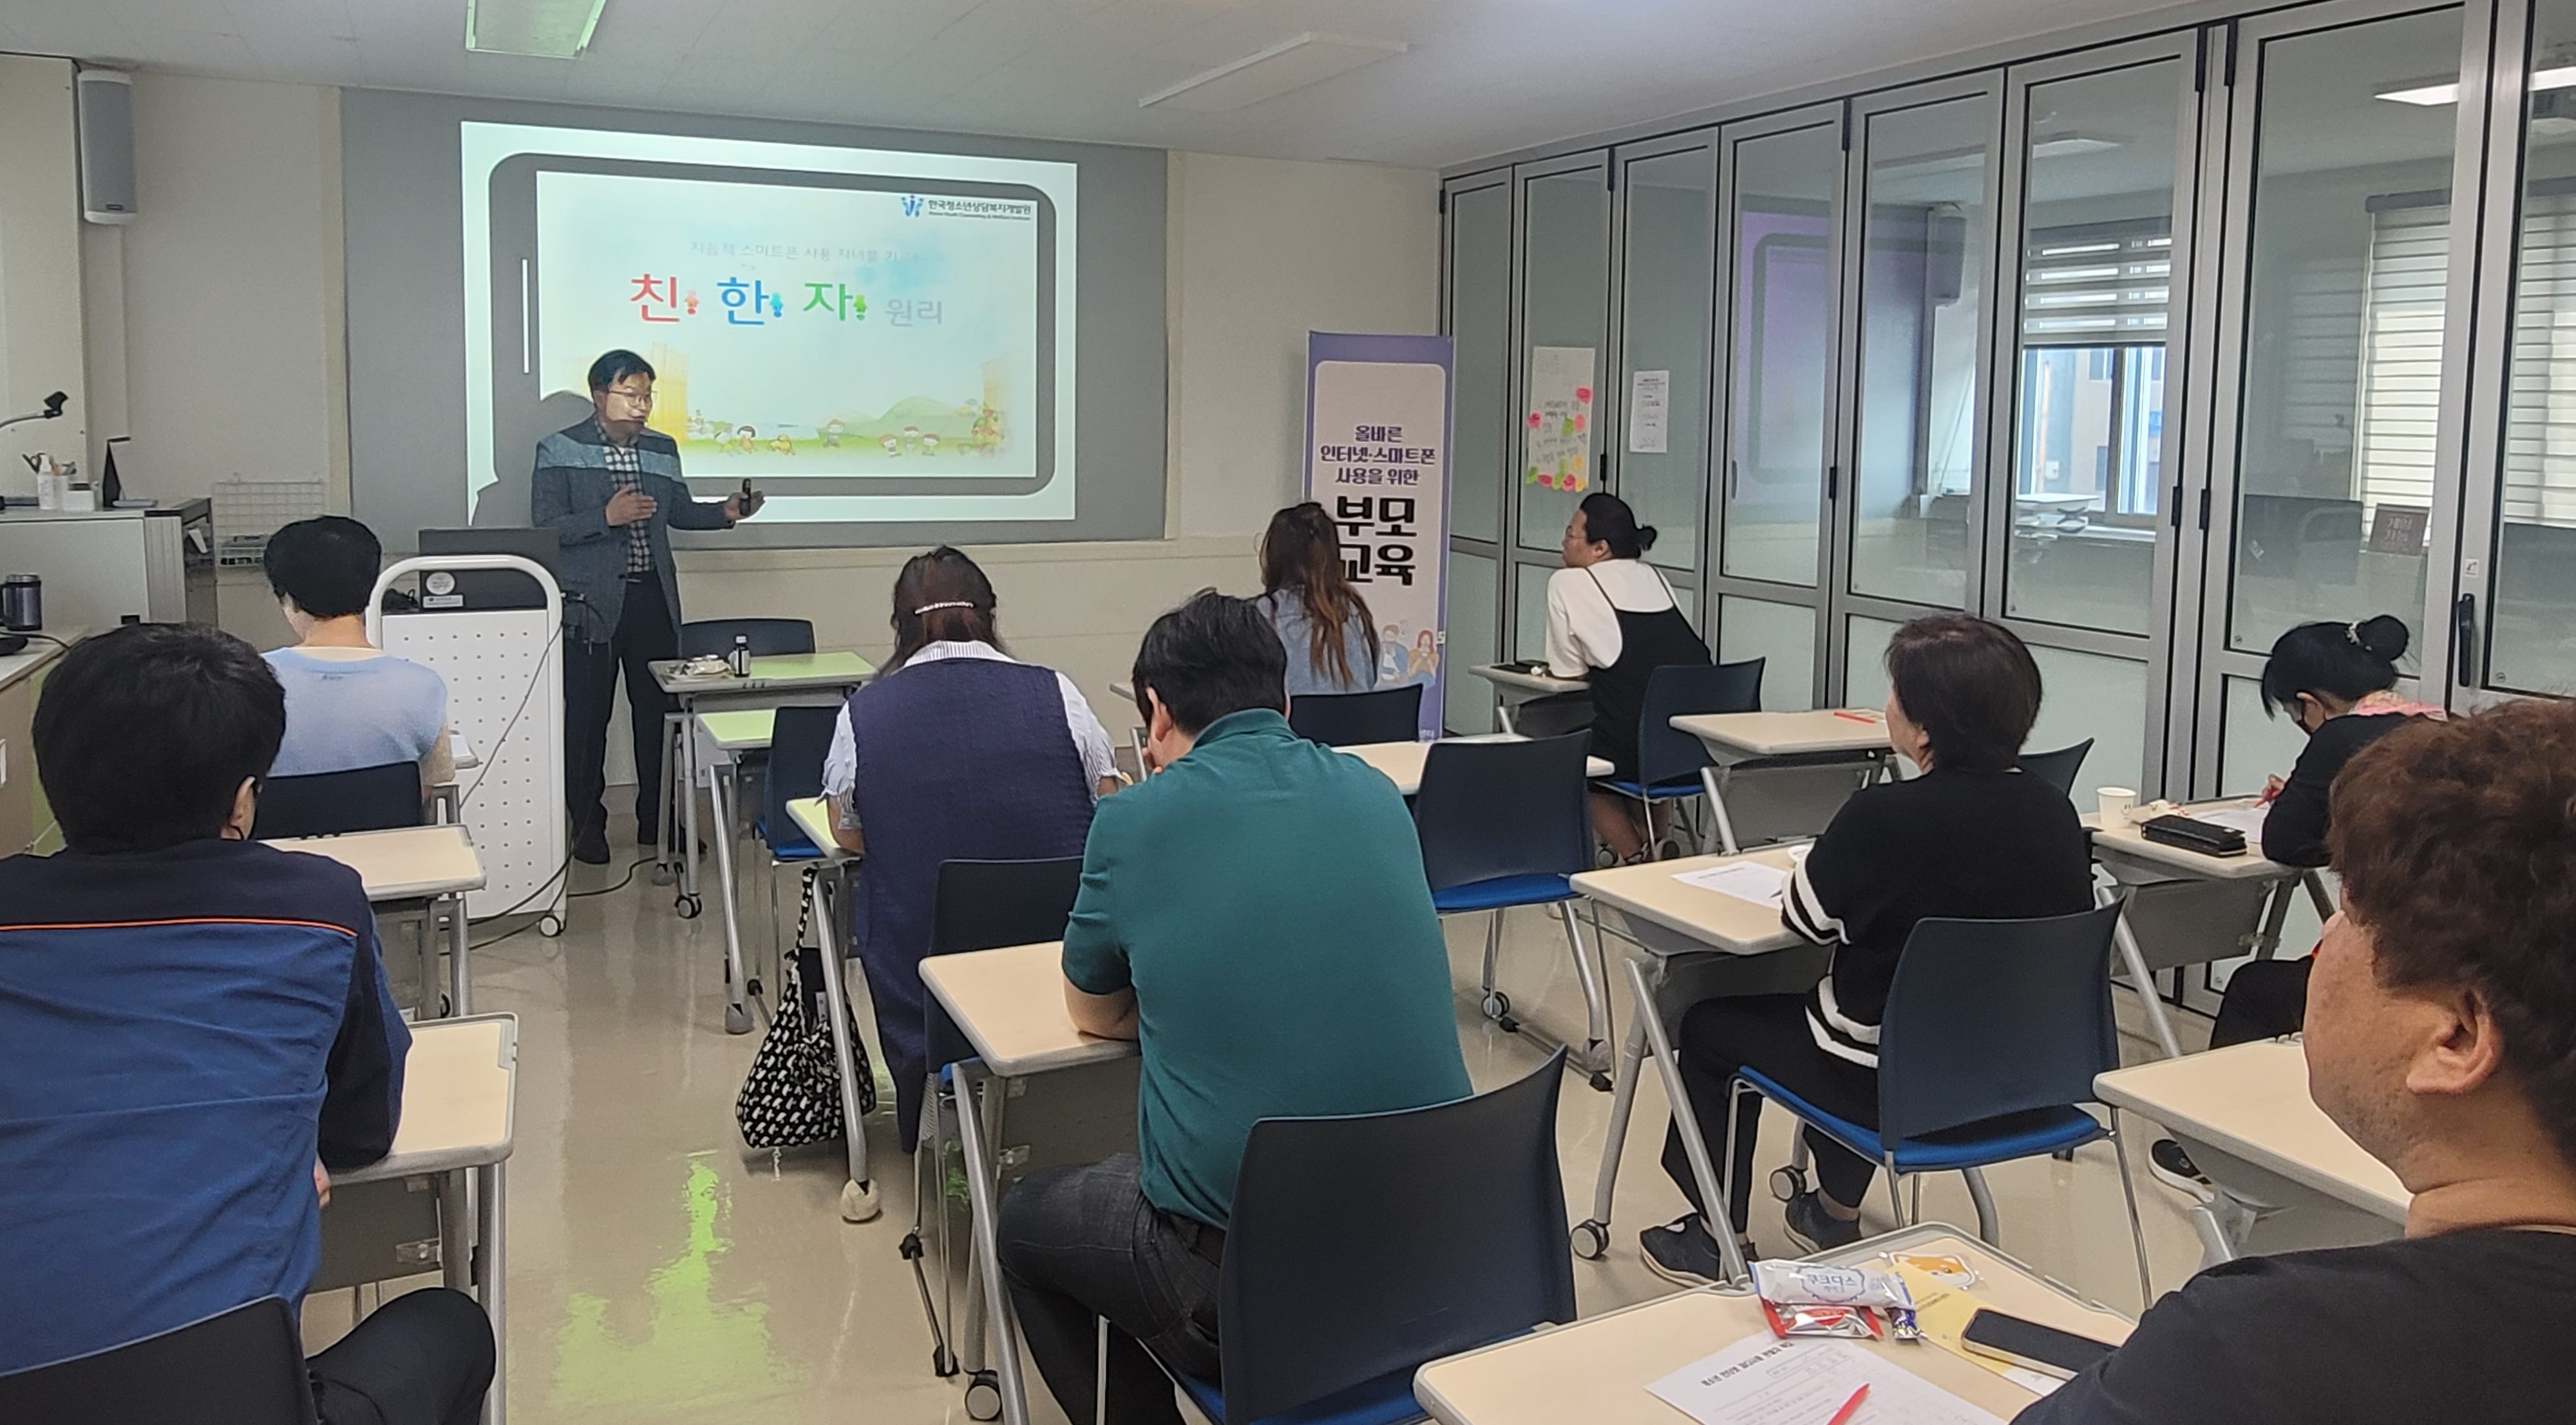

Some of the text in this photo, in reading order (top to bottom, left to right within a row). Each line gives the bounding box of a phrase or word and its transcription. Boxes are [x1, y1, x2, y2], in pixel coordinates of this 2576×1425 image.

[885, 298, 943, 328] 원리
[1354, 424, 1403, 443] 올바른
[1334, 467, 1419, 486] 사용을 위한
[1334, 495, 1417, 537] 부모
[1338, 543, 1416, 587] 교육
[1808, 1272, 1860, 1287] 쿠크다스
